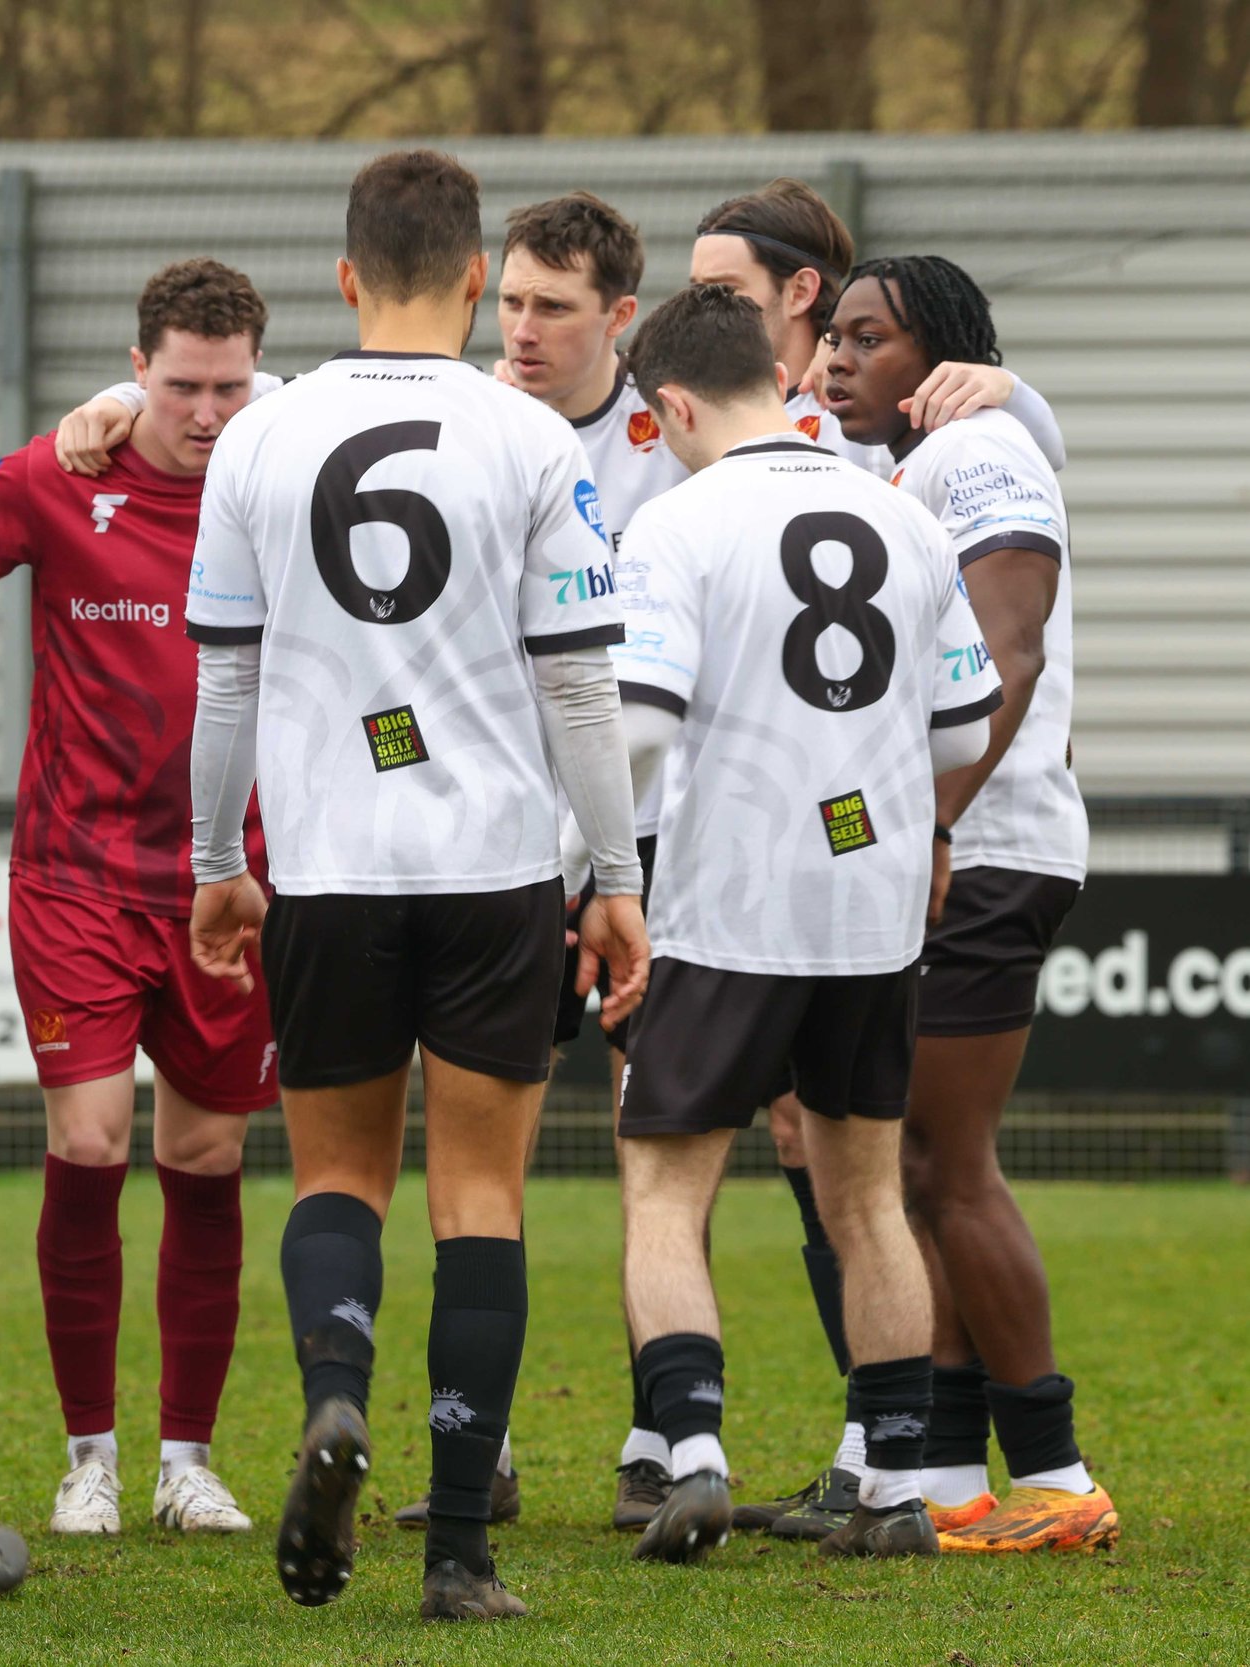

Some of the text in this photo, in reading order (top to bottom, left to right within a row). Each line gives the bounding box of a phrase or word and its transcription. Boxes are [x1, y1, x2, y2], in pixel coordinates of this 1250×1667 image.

[311, 420, 451, 624] 6
[71, 598, 170, 627] Keating
[780, 511, 896, 712] 8
[376, 711, 412, 734] BIG
[373, 729, 408, 745] YELLOW
[376, 737, 412, 758] SELF
[379, 751, 418, 767] STORAGE
[831, 795, 864, 818] BIG
[830, 821, 865, 842] SELF
